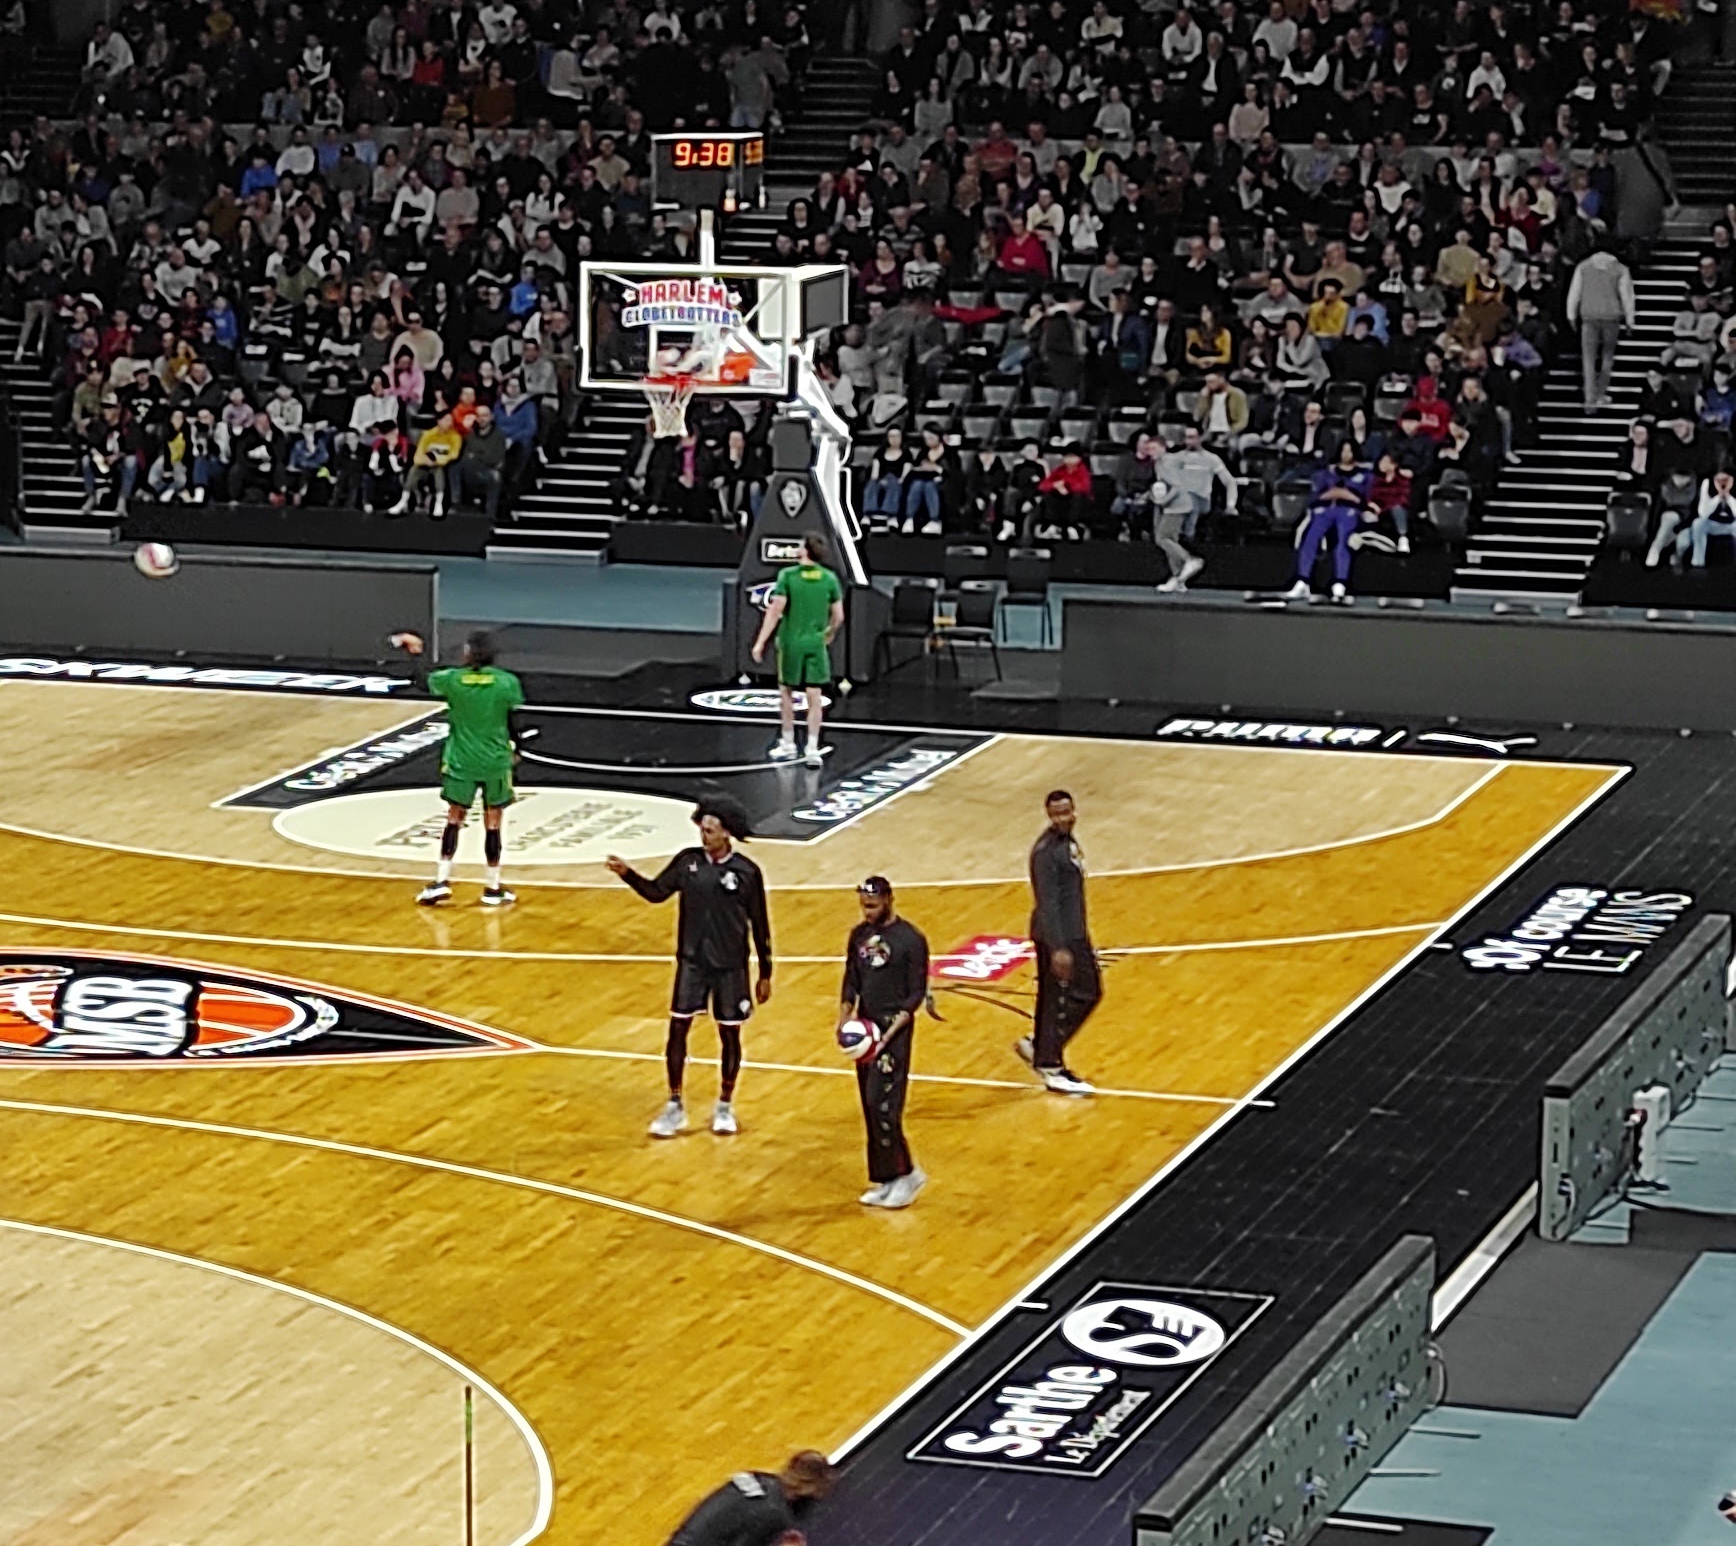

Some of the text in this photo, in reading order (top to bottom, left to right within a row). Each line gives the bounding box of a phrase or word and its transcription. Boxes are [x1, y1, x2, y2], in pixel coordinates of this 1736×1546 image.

[640, 282, 725, 308] HARLEM
[1542, 890, 1693, 973] LE MANS
[48, 975, 194, 1056] MSB
[943, 1364, 1119, 1459] Sarthe
